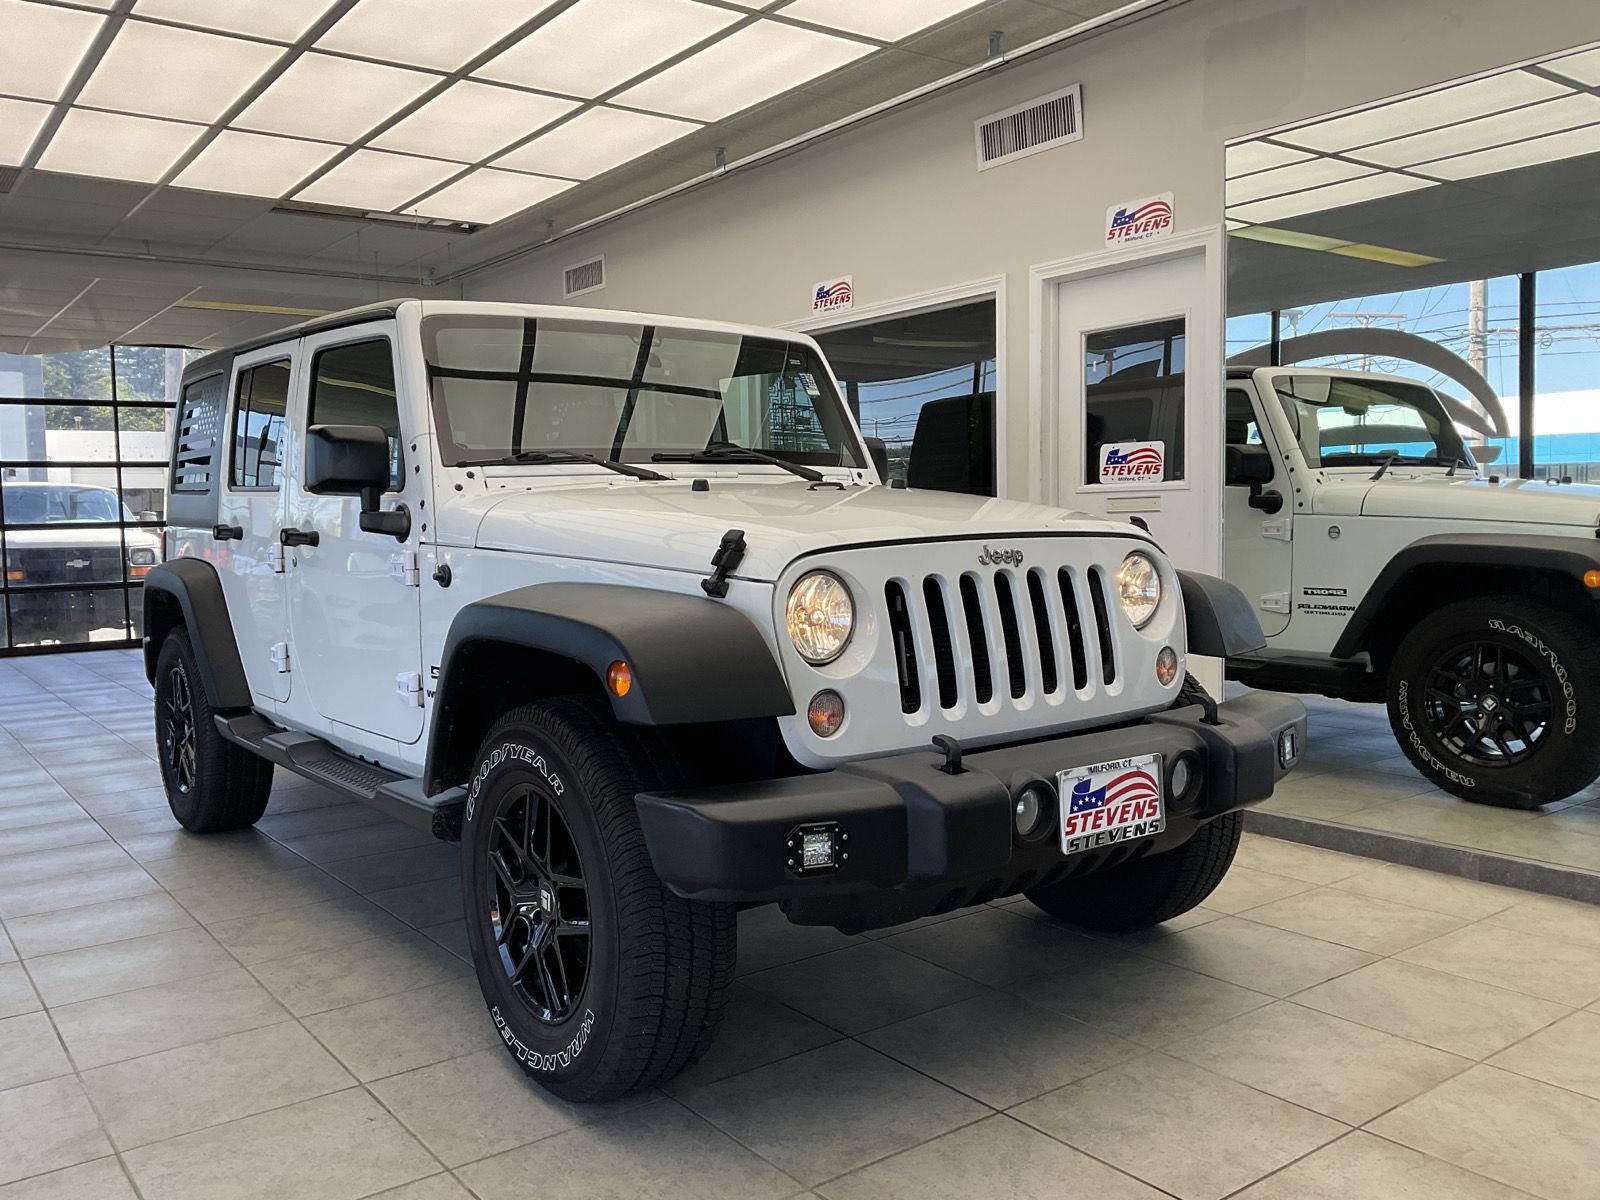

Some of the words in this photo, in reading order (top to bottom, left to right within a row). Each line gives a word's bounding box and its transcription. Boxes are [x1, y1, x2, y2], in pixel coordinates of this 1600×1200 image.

[1106, 216, 1171, 241] STEVENS
[813, 293, 851, 310] STEVENS
[1101, 464, 1162, 476] STEVENS
[978, 545, 1023, 567] Jeep
[1122, 759, 1132, 768] CT
[466, 743, 564, 821] GOODYEAR
[1065, 798, 1159, 836] STEVENS
[1068, 820, 1160, 853] STEVENS
[491, 1006, 595, 1071] WRANGLER
